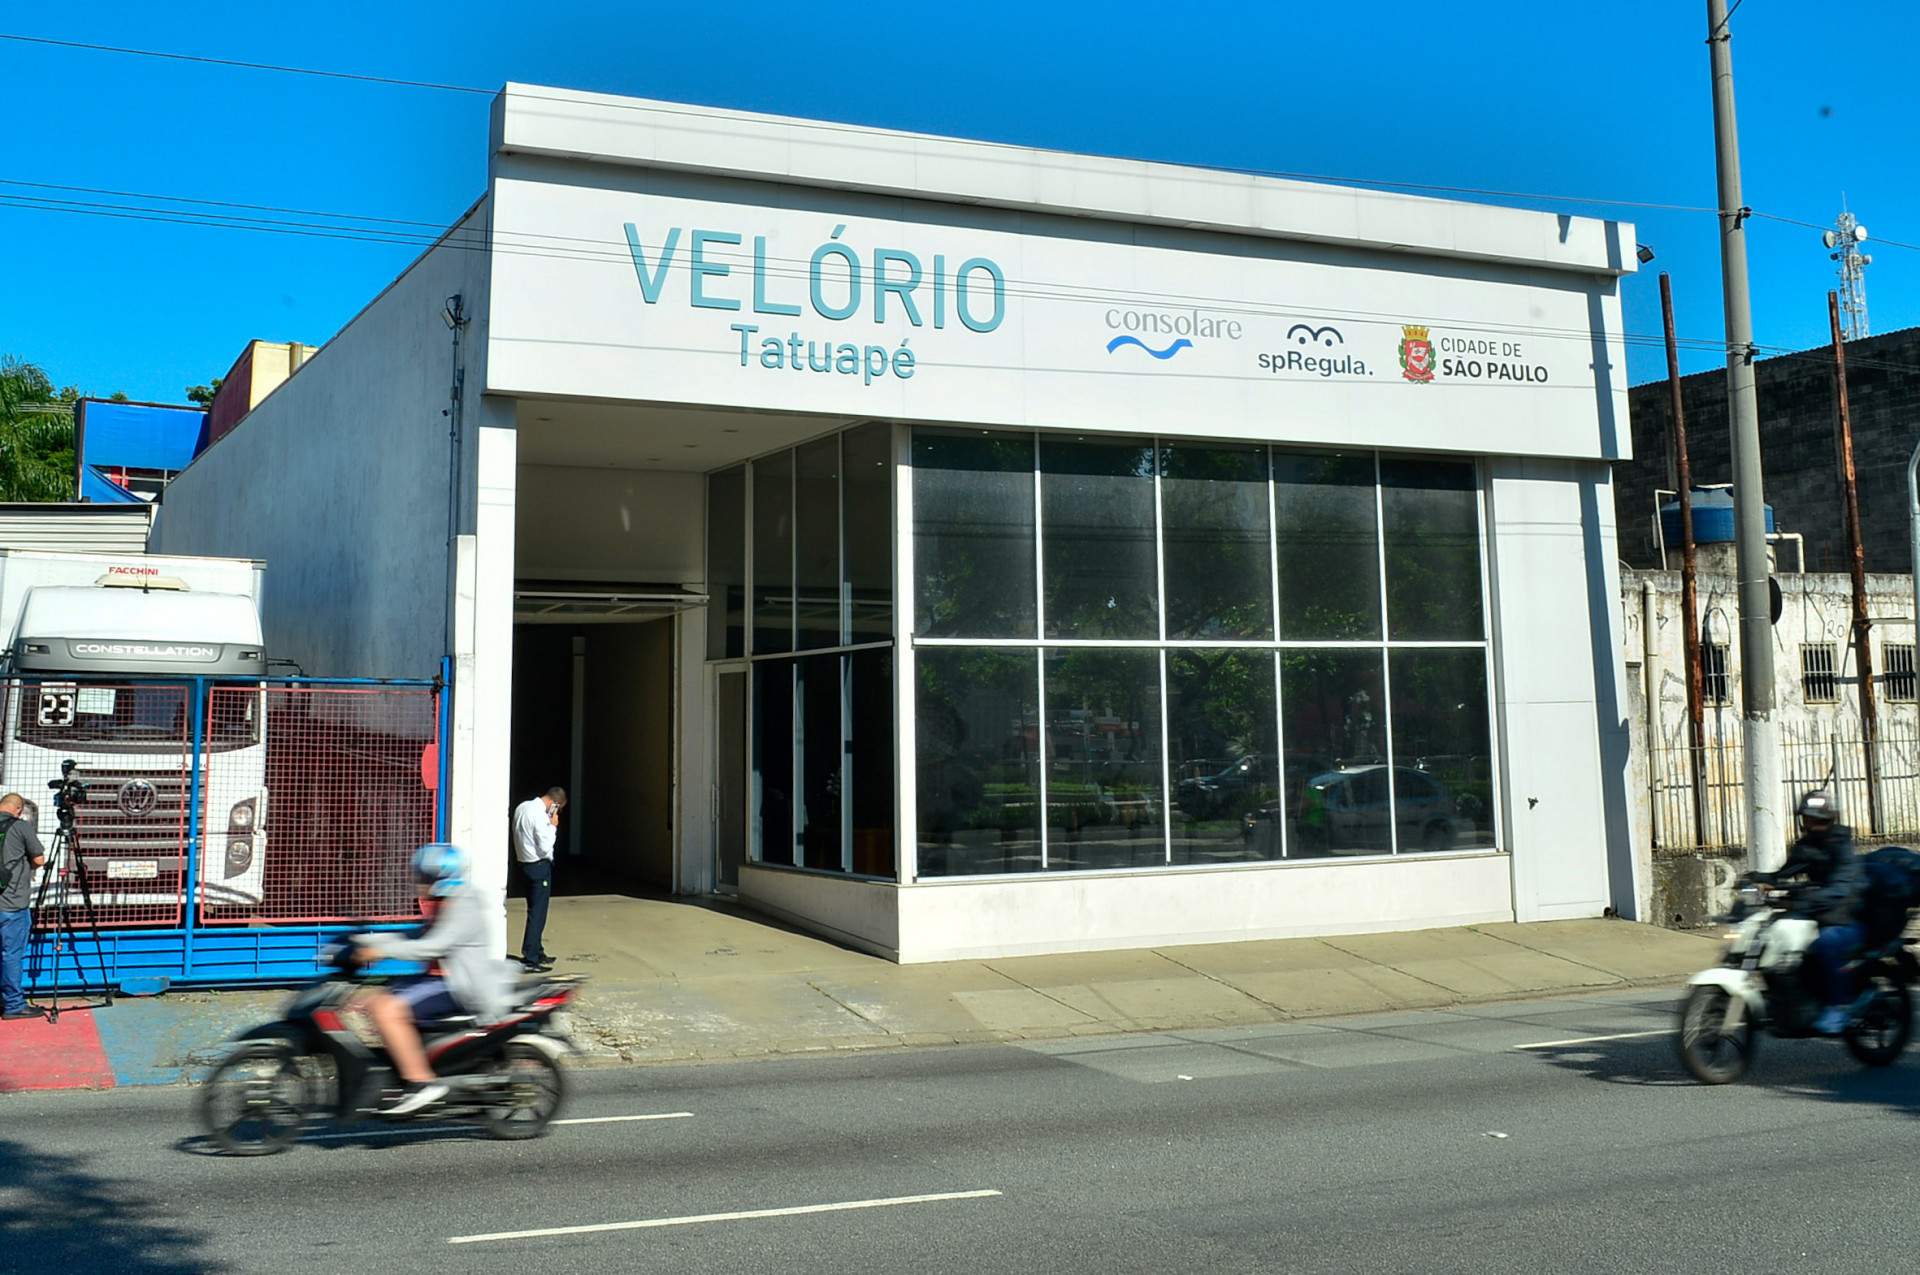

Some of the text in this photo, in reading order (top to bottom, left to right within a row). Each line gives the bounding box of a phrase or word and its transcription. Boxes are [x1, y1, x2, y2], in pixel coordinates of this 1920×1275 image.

[624, 222, 1005, 333] VELÓRIO
[1105, 309, 1242, 340] consolare
[731, 323, 916, 386] Tatuapé
[1441, 337, 1522, 358] CIDADE DE
[1257, 350, 1374, 377] spRegula.
[1442, 355, 1482, 378] SÃO
[1487, 362, 1548, 383] PAULO
[108, 566, 158, 576] FACCHINI
[75, 643, 214, 657] CONSTELLATION
[40, 694, 73, 724] 23
